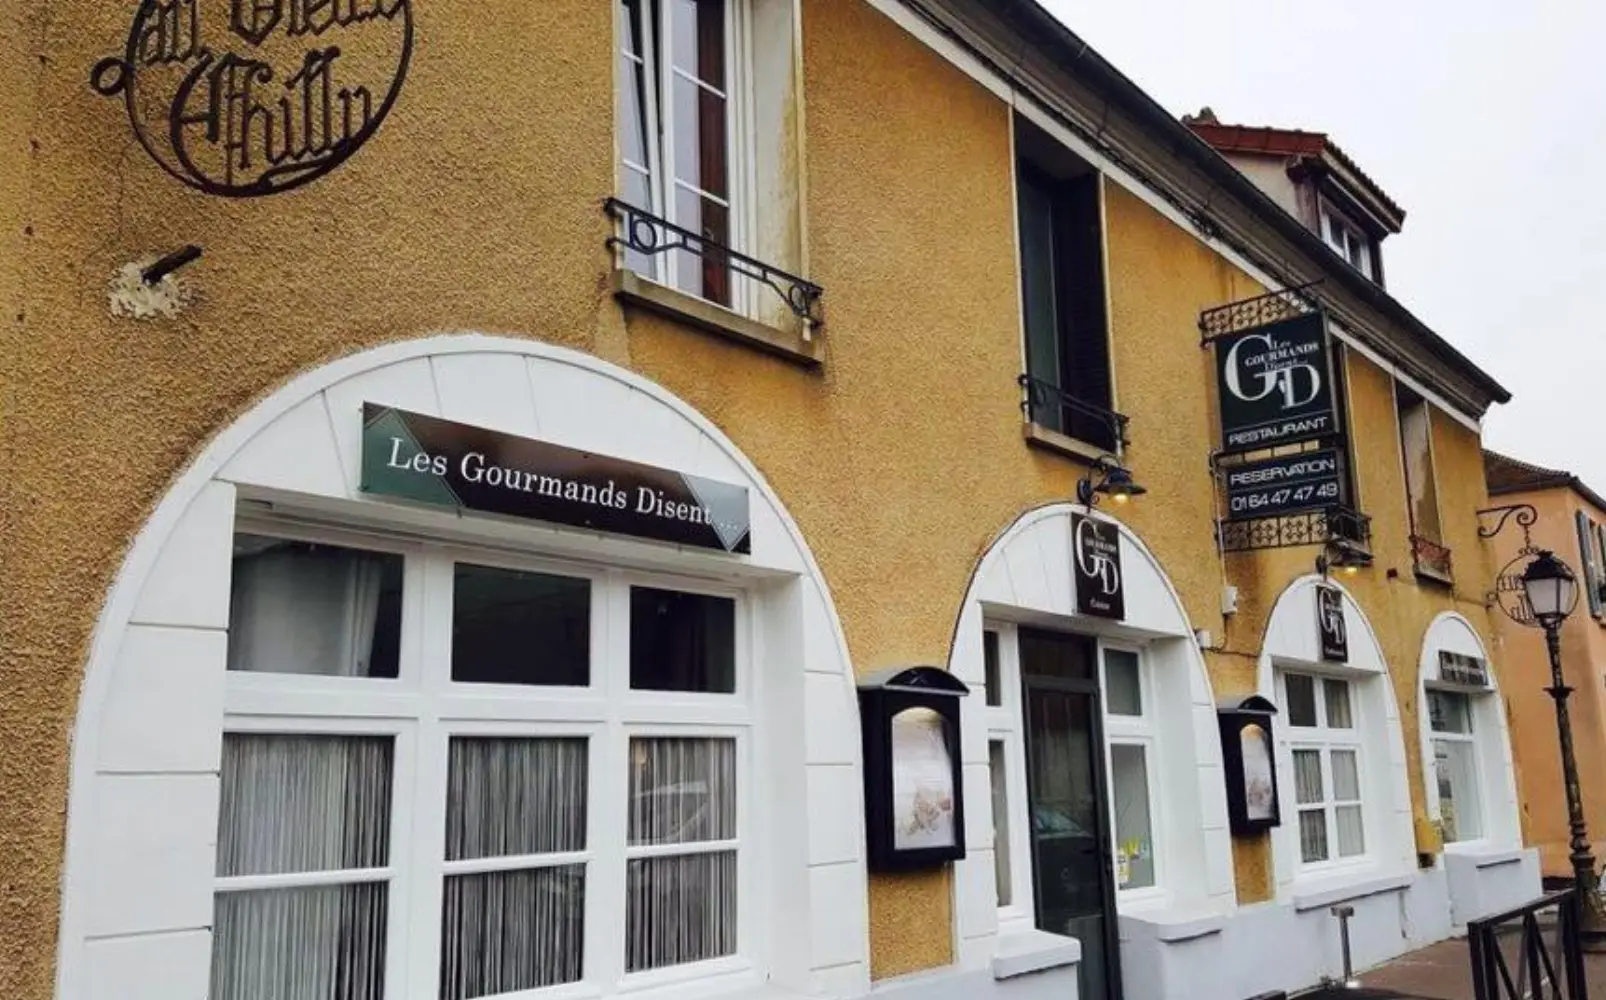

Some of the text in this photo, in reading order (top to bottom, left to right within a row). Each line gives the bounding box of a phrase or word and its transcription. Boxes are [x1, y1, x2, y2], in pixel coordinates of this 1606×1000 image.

[1229, 416, 1328, 445] RESTAURANT
[386, 437, 448, 477] Les
[460, 452, 627, 510] Gourmands
[1230, 459, 1336, 486] RESERVATION
[1231, 496, 1248, 511] 01
[1249, 493, 1269, 508] 64
[1270, 489, 1291, 504] 47
[1293, 485, 1314, 501] 47
